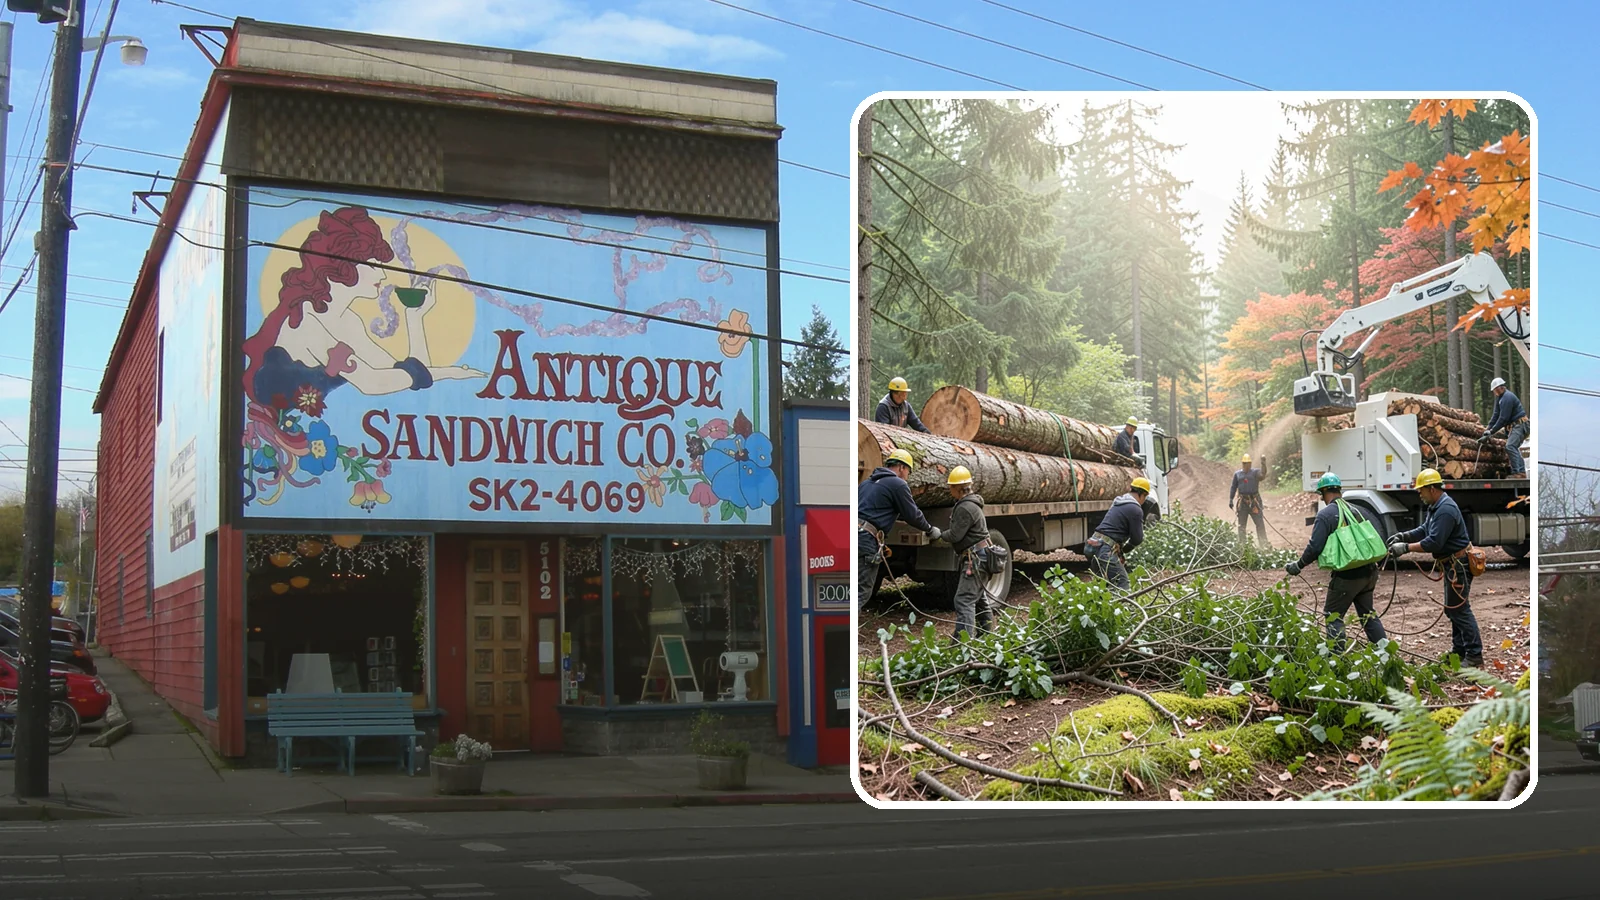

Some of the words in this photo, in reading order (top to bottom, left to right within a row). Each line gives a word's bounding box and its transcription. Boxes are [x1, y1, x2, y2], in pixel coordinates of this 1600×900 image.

[476, 329, 723, 421] ANTIQUE
[361, 408, 604, 467] SANDWICH
[617, 422, 685, 469] CO.
[468, 477, 646, 514] SK2-4069
[540, 542, 552, 599] 5102
[809, 555, 834, 569] BOOKS
